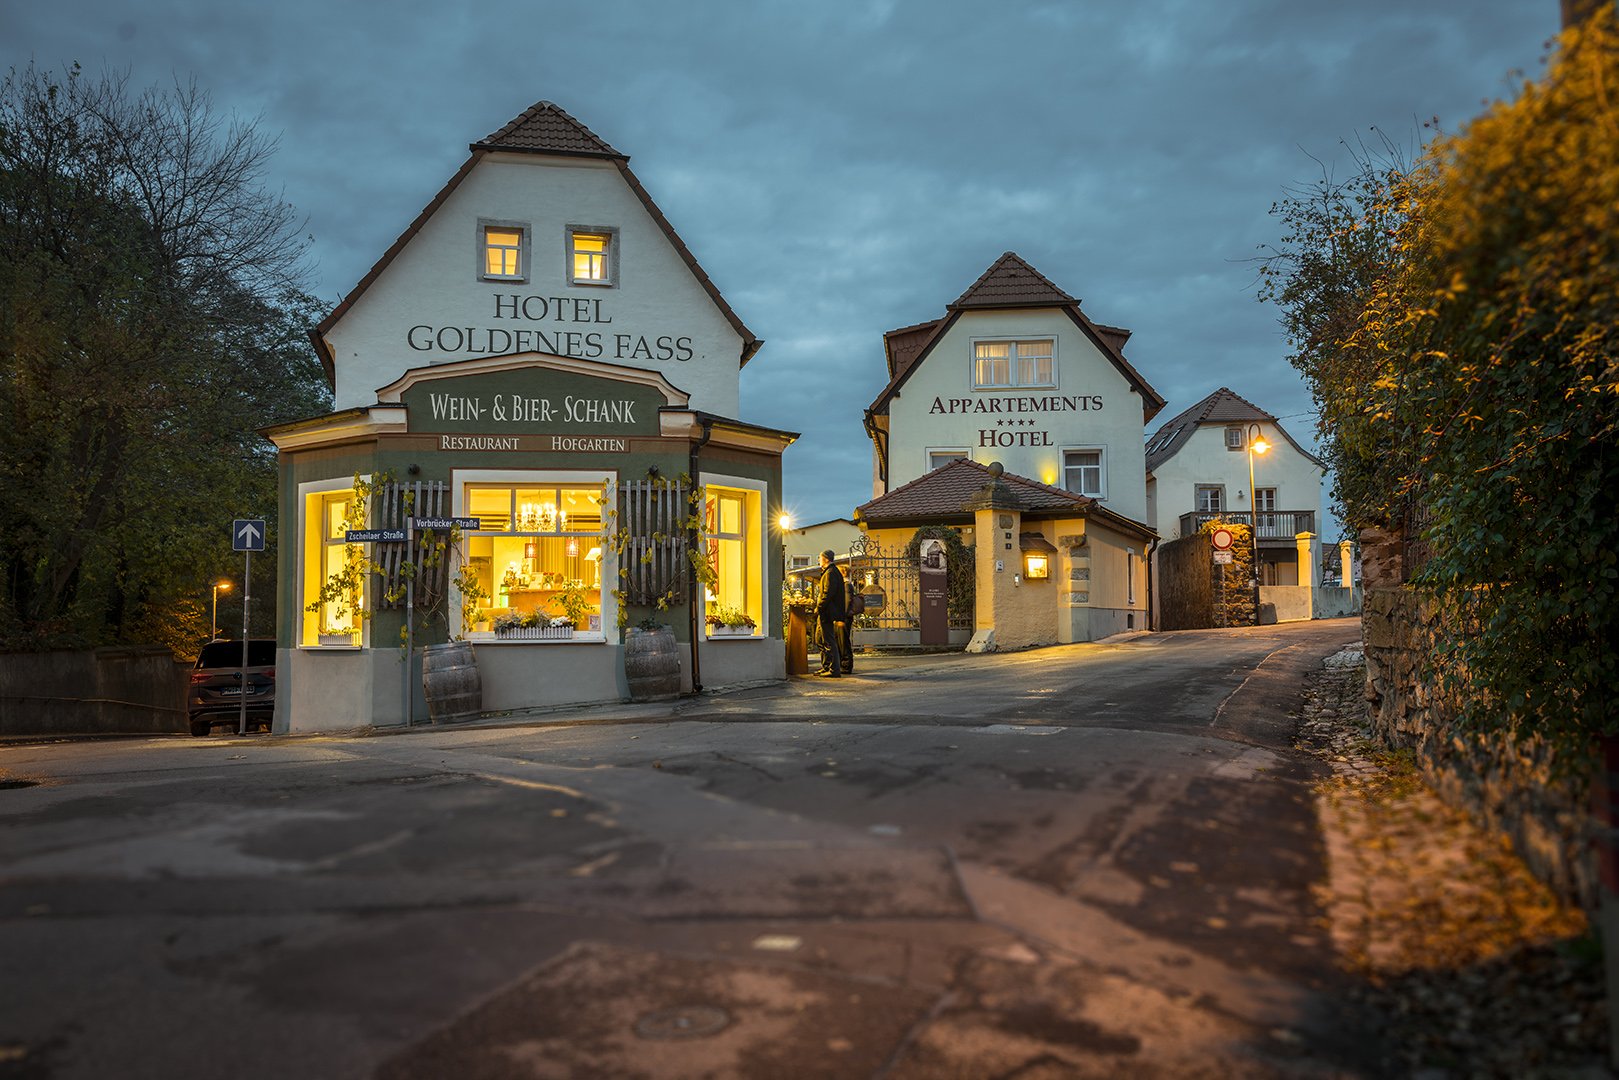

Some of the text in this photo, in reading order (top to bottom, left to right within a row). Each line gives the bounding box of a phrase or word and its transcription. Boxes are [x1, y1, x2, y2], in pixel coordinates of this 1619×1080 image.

[493, 293, 613, 324] HOTEL
[407, 325, 694, 362] GOLDENES FASS
[492, 394, 508, 422] &
[564, 395, 636, 424] SCHANK
[929, 395, 1103, 415] APPARTEMENTS
[441, 435, 625, 451] RESTAURANT HOFGARTEN
[978, 429, 1054, 448] HOTEL
[416, 519, 452, 528] Vorbrücker
[349, 531, 404, 541] Zscheilaer Straße
